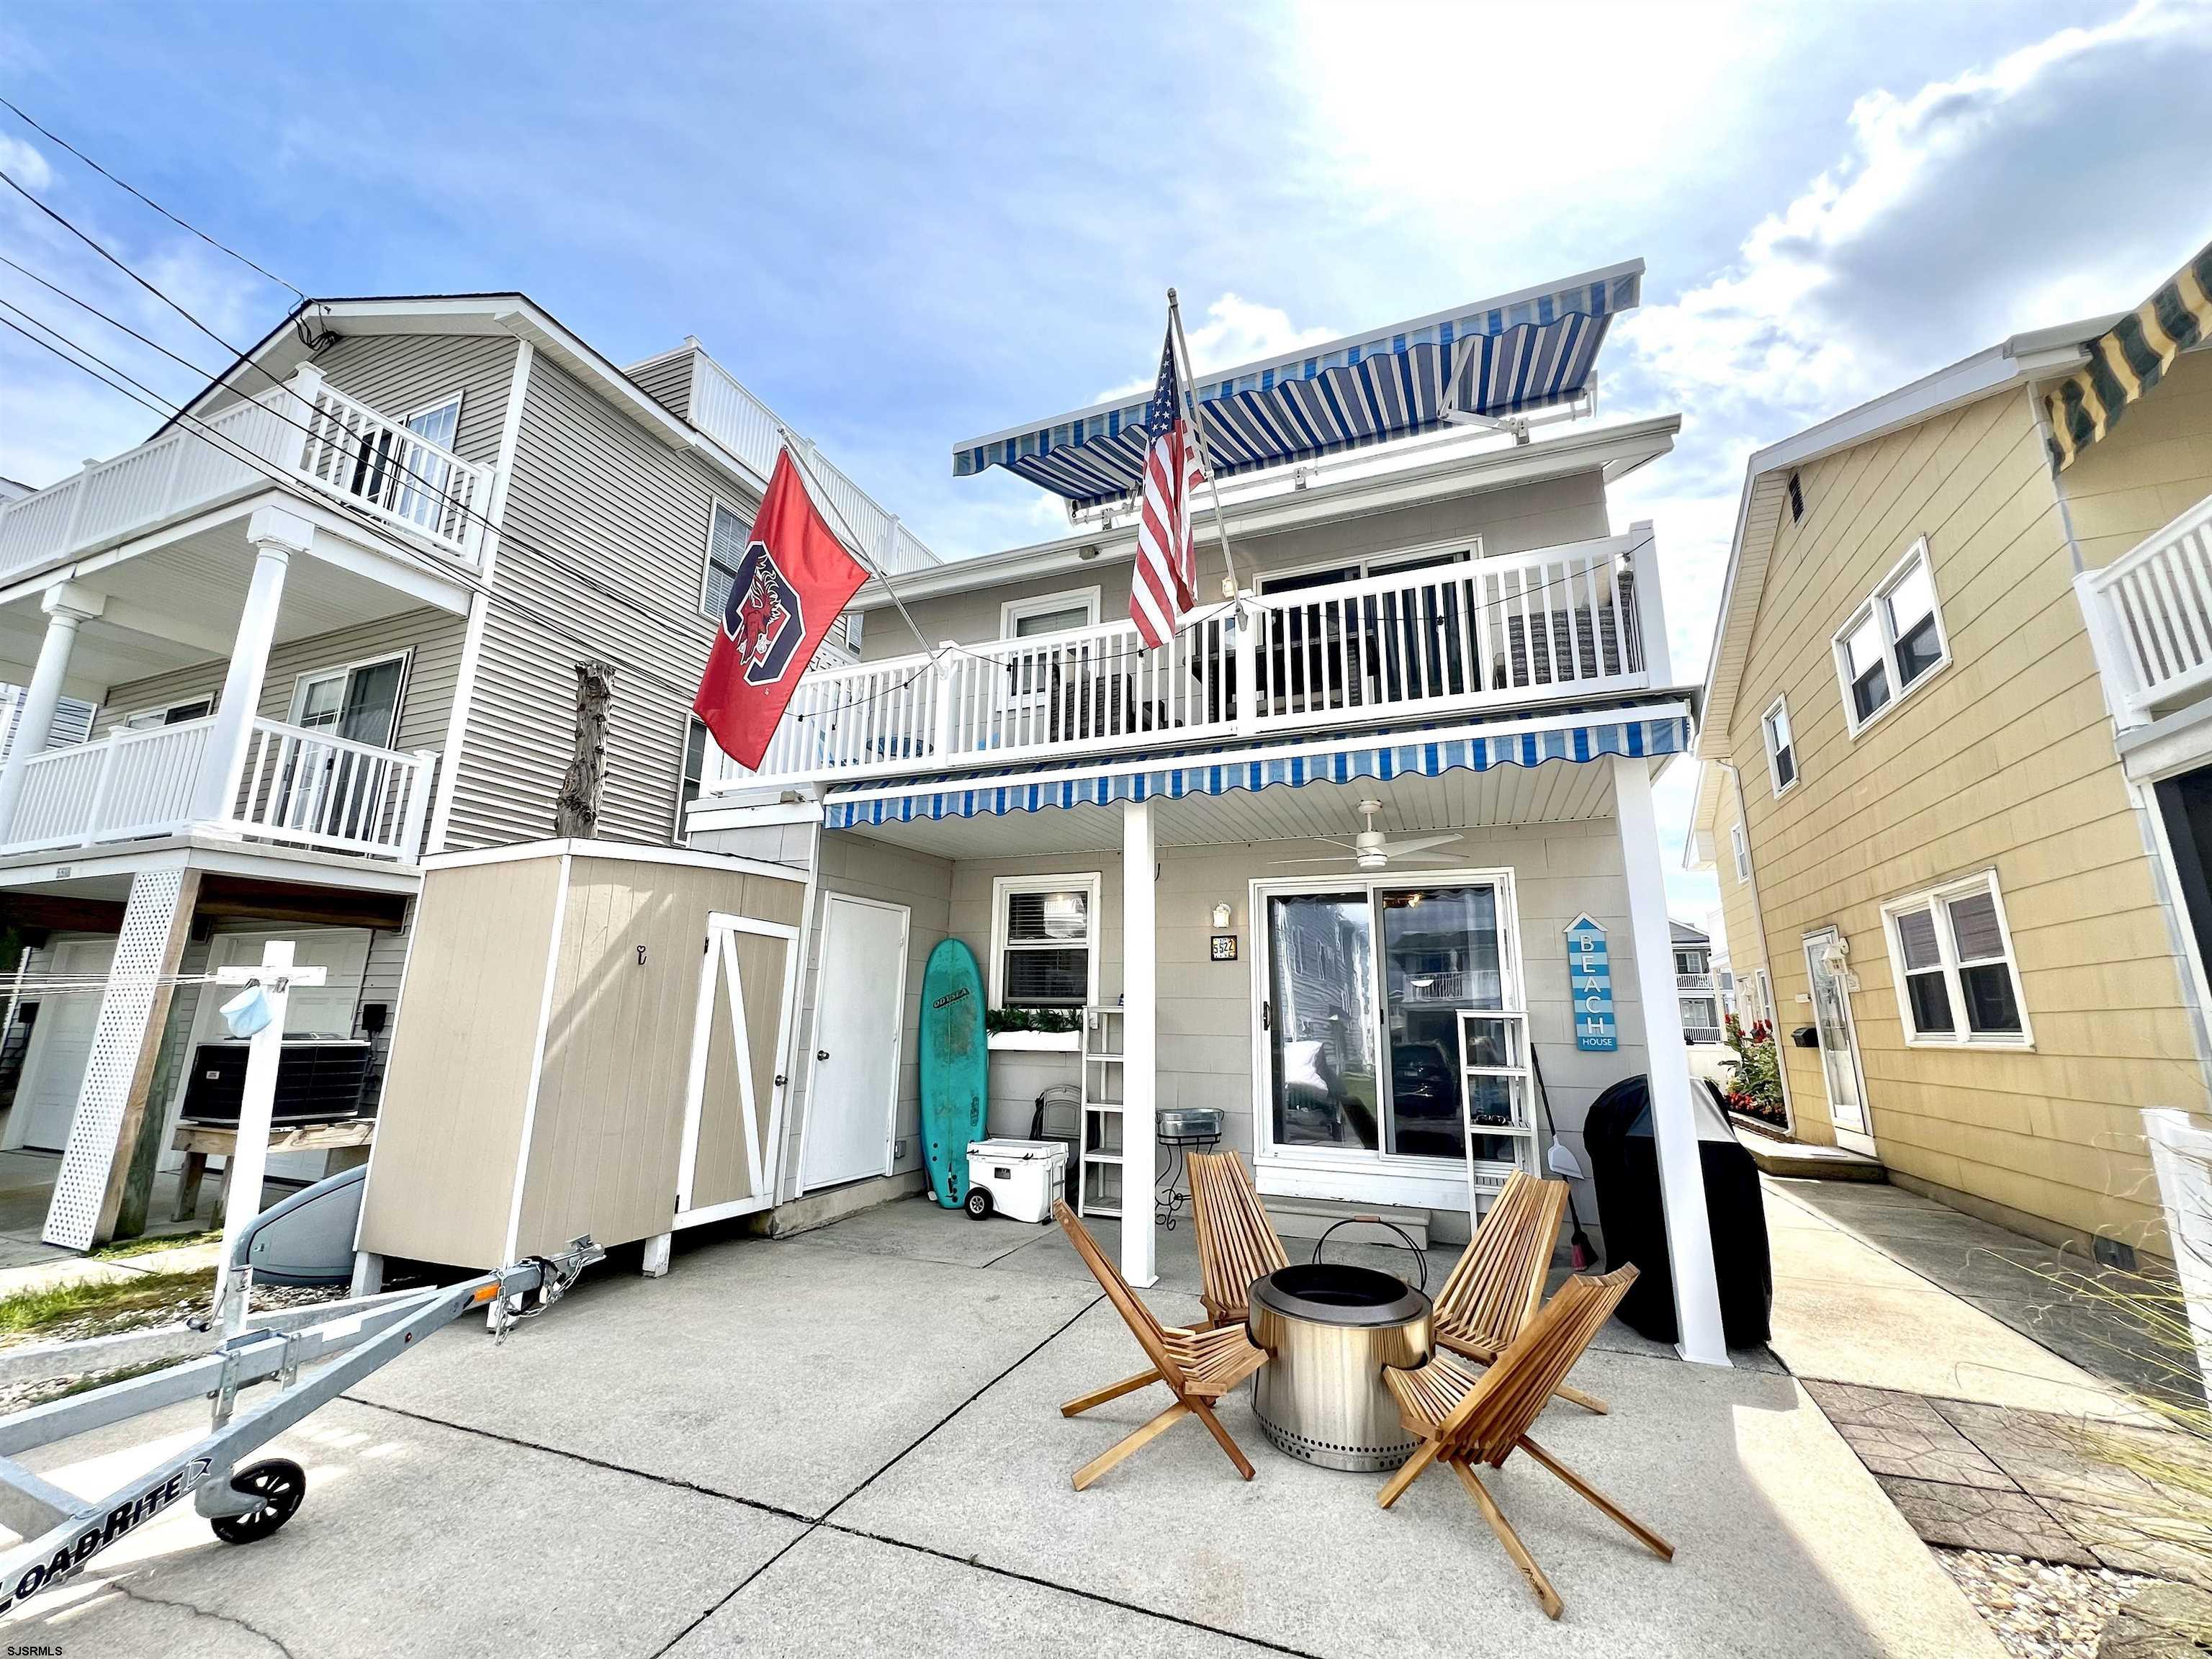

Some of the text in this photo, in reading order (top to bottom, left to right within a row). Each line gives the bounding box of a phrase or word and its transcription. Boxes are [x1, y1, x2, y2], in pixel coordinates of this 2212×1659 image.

[1213, 939, 1233, 954] 5522
[1579, 935, 1604, 1035] BEACH
[1582, 1038, 1613, 1046] HOUSE
